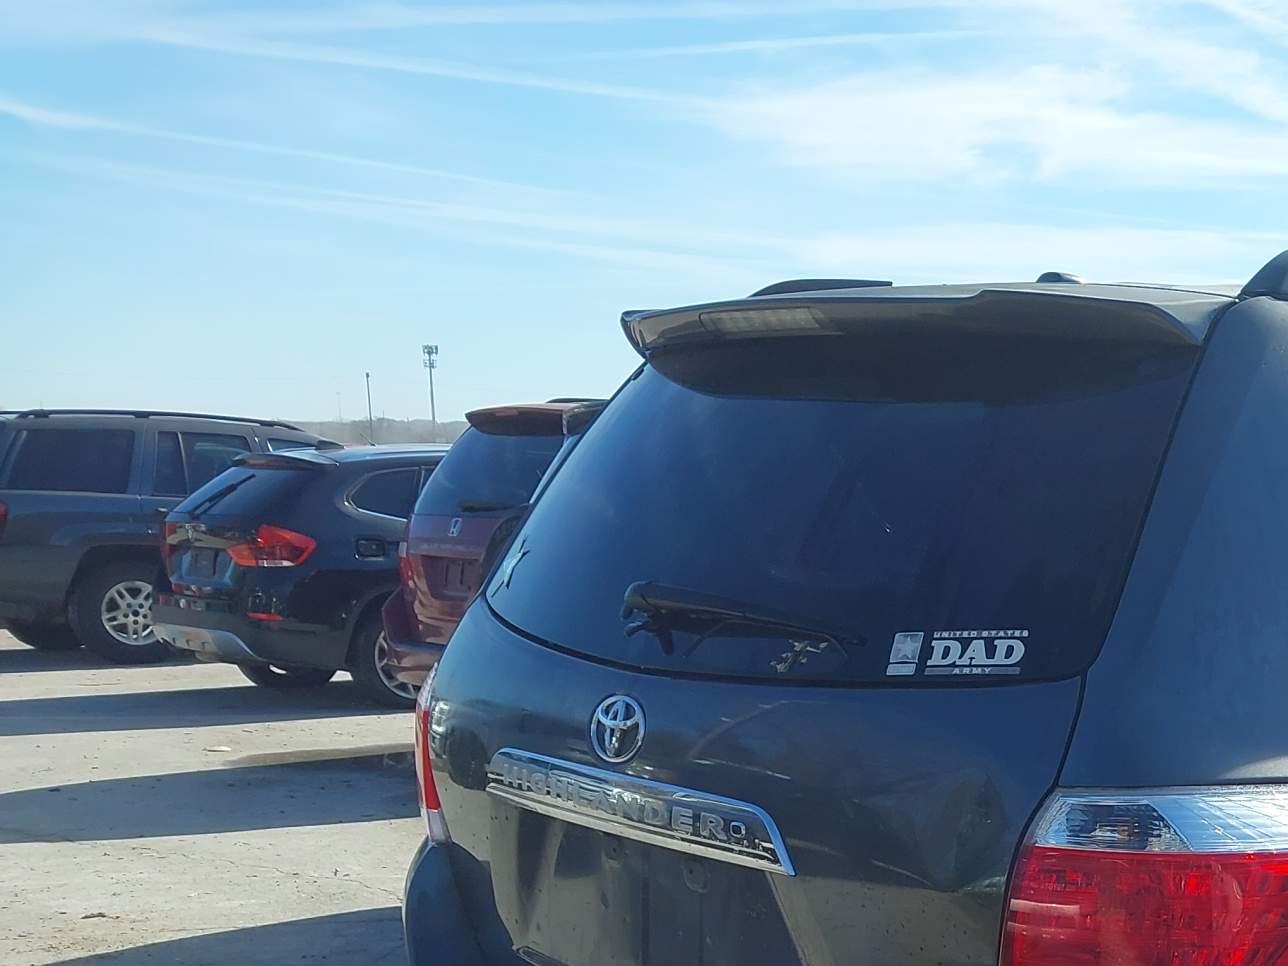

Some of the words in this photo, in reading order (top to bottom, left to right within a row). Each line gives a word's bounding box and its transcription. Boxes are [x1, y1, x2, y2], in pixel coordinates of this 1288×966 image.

[981, 630, 1029, 638] STATES
[926, 639, 1026, 666] DAD
[951, 667, 992, 675] ARMY
[503, 763, 728, 840] HIGHLANDER
